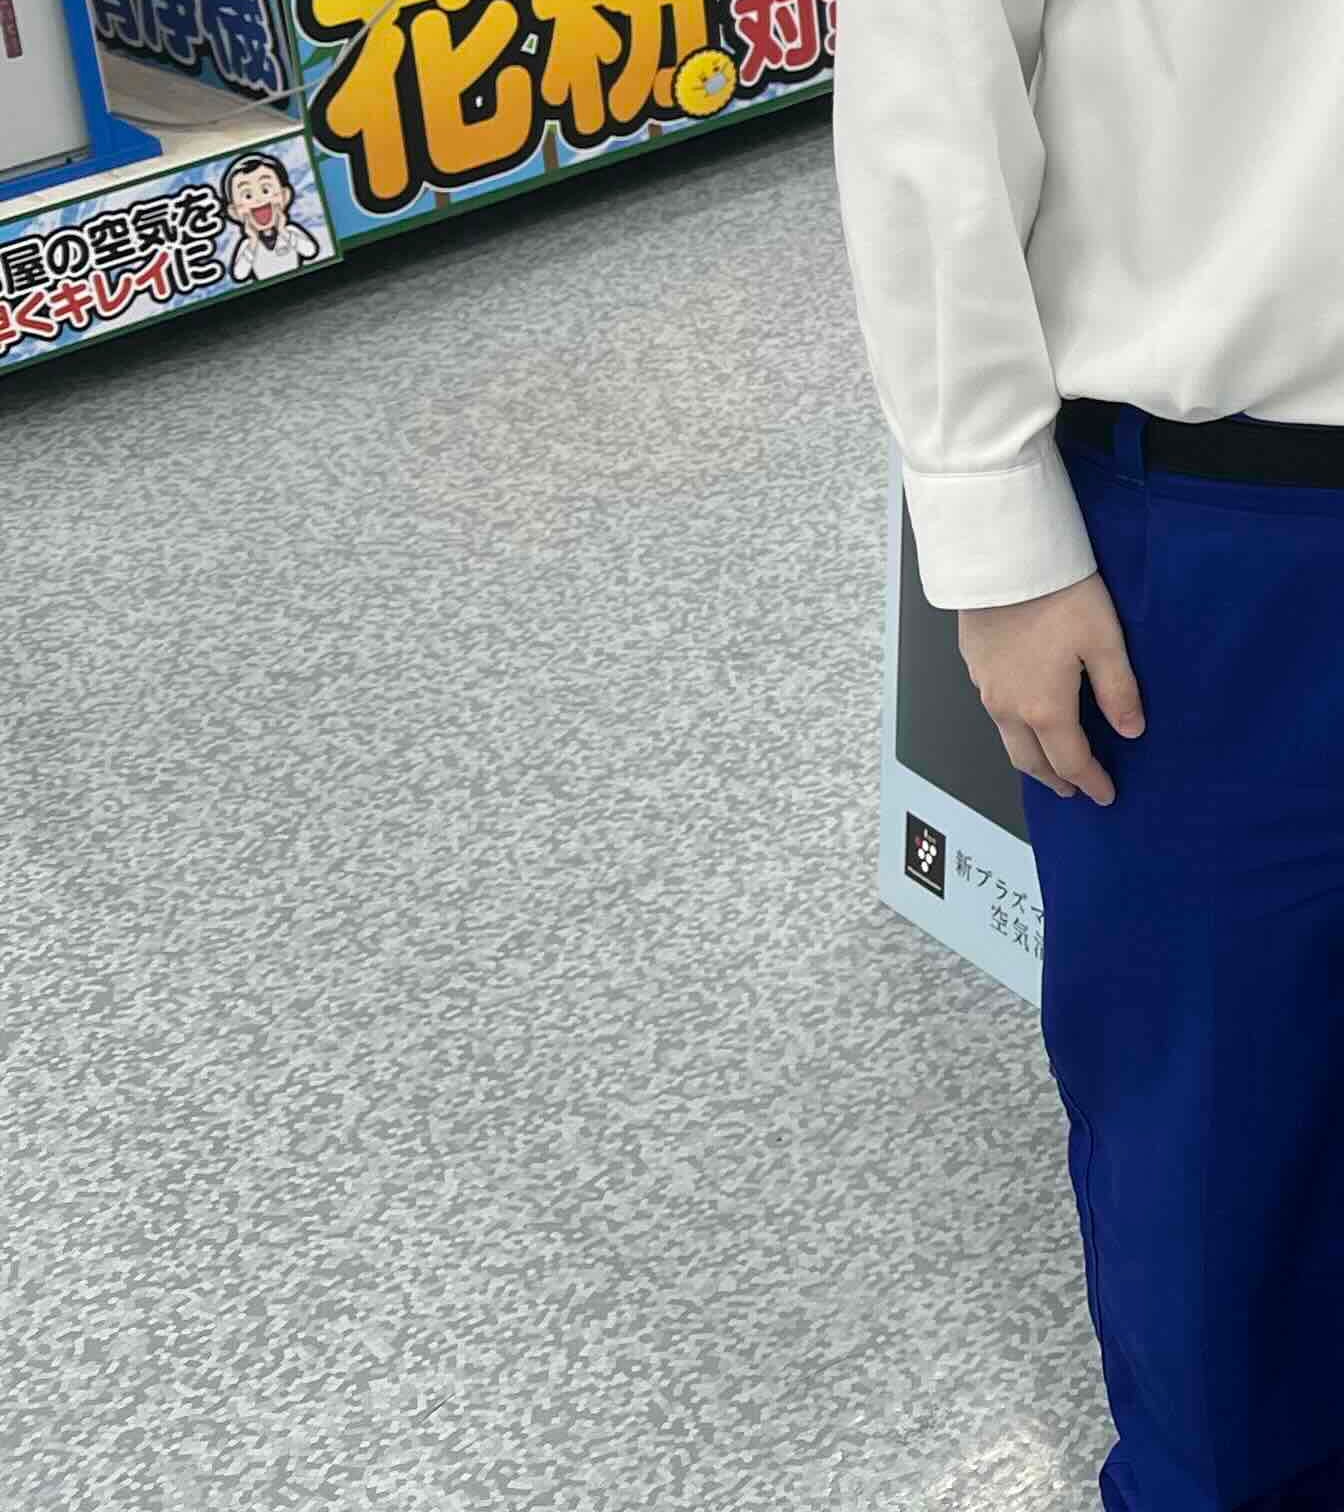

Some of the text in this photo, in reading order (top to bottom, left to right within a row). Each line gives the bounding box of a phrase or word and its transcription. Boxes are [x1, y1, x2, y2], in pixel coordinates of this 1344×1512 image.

[2, 190, 222, 296] 屋の空気を
